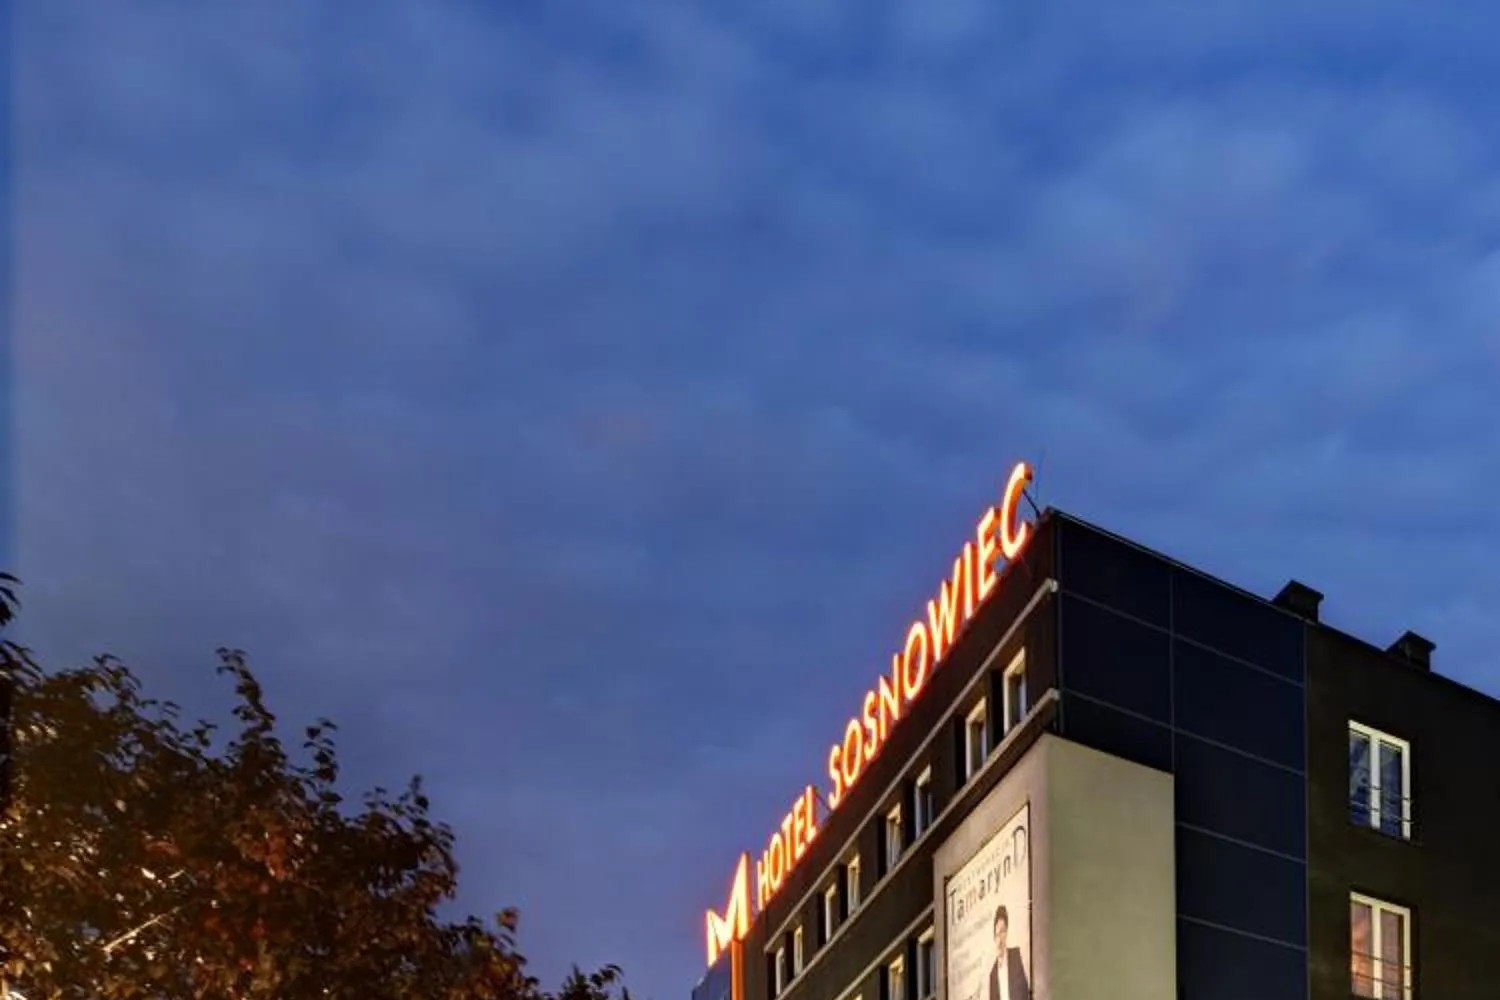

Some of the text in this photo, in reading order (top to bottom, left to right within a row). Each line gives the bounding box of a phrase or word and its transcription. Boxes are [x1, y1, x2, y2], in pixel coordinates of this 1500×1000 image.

[706, 852, 750, 968] M
[757, 784, 817, 912] HOTEL
[828, 461, 1032, 811] SOSNOWIEC
